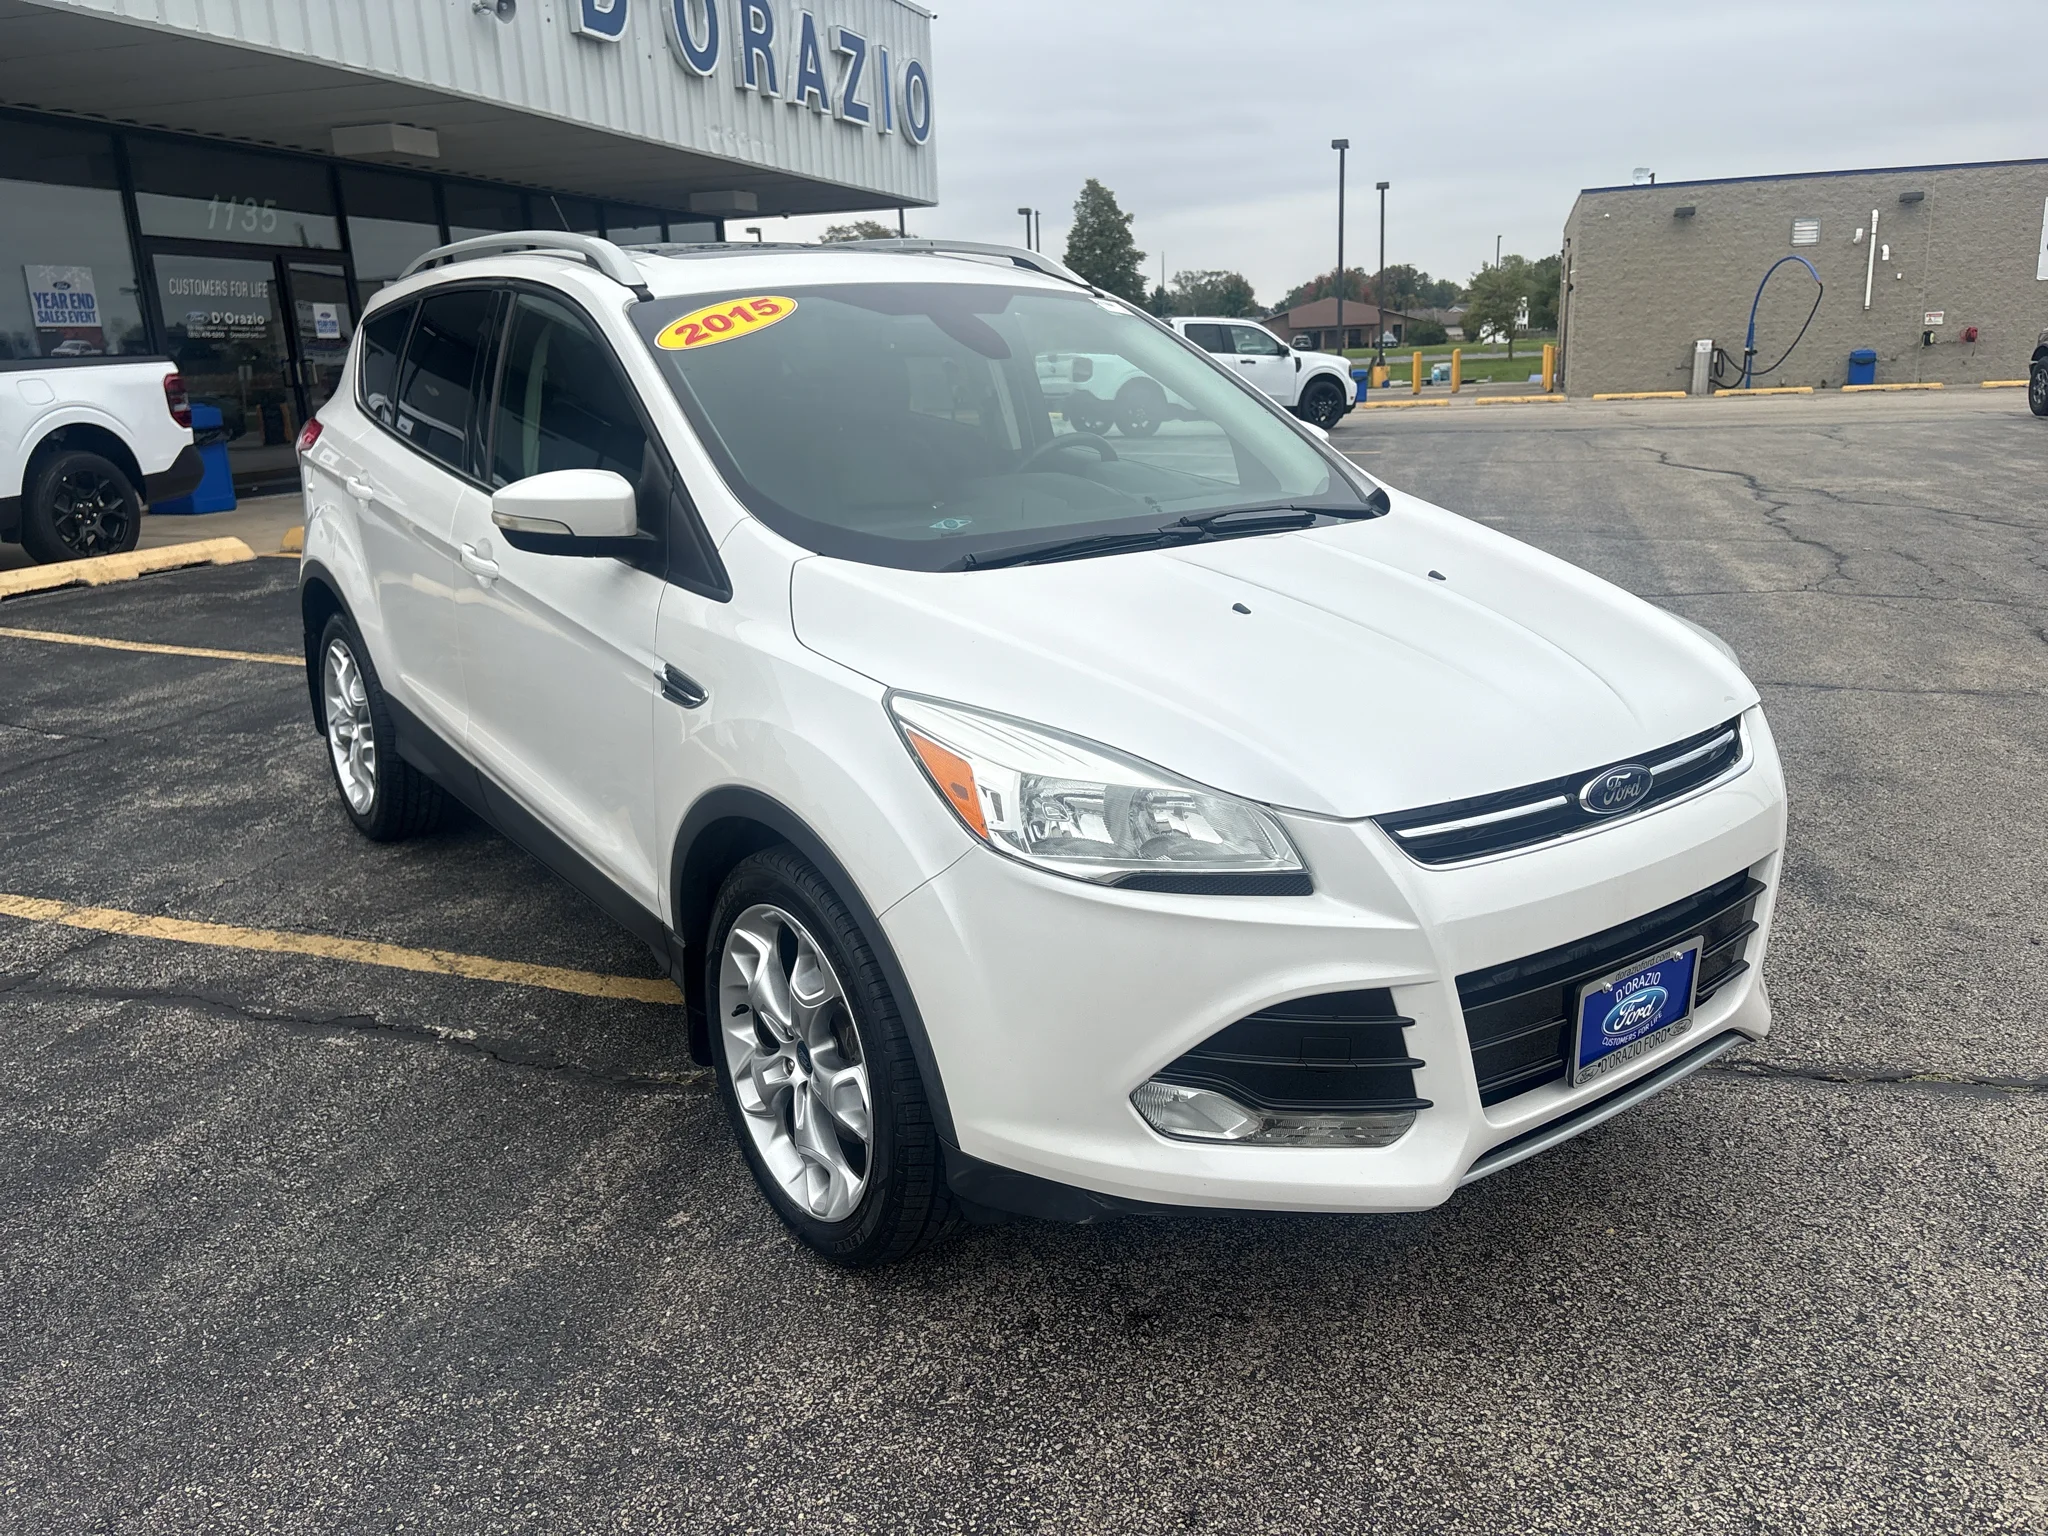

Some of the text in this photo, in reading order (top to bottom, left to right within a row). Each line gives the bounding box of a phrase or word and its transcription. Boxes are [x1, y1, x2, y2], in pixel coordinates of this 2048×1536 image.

[571, 0, 931, 146] ORAZIO
[208, 193, 277, 233] 1135
[33, 292, 94, 309] YEAR END
[169, 278, 268, 298] CUSTOMERS FOR LIFE
[38, 310, 96, 323] SALES EVENT
[211, 312, 265, 325] D'Orazio
[675, 298, 782, 345] 2015
[1603, 772, 1642, 805] Ford
[1615, 951, 1671, 981] dorazioford.com
[1615, 972, 1661, 1003] D'ORAZIO
[1602, 1011, 1663, 1046] CUSTOMERS FOR LIFE
[1614, 996, 1657, 1031] Ford
[1601, 1042, 1642, 1074] D'ORAZIO
[1644, 1028, 1667, 1052] FORD
[834, 1228, 865, 1254] KELLY
